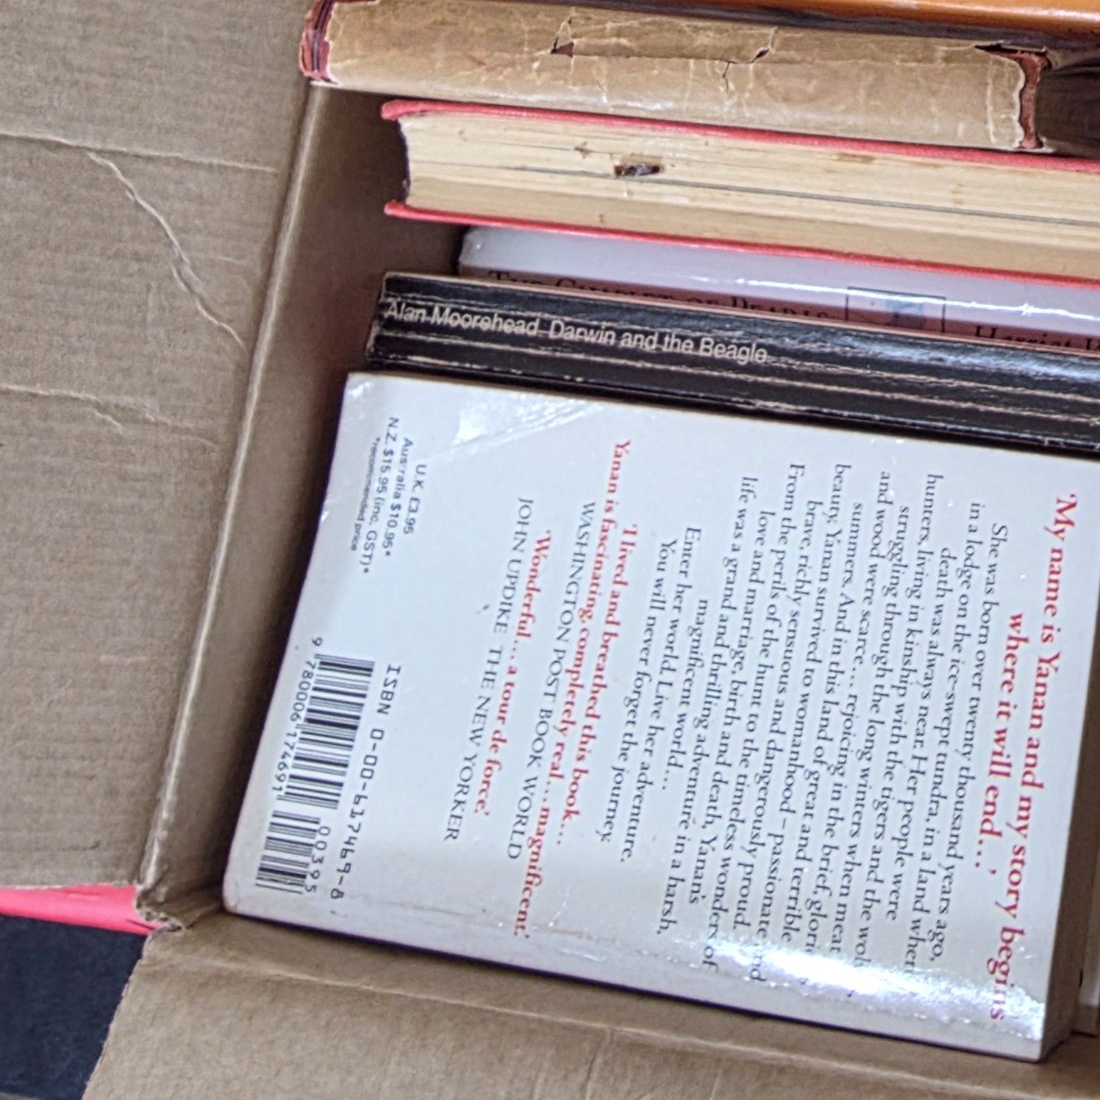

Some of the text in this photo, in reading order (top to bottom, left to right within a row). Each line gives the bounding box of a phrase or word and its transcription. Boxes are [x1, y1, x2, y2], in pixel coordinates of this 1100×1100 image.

[384, 300, 769, 367] Alan Moorehead Darwin and the Beagle
[375, 447, 394, 494] $15.95
[391, 436, 413, 500] Australia
[606, 439, 631, 494] Yanan
[367, 495, 385, 525] (inc.
[402, 463, 427, 534] U.K. £3.95
[603, 498, 618, 513] is
[1046, 492, 1078, 541] 'My
[349, 522, 362, 551] price
[611, 539, 636, 586] lived
[577, 517, 617, 623] fascinating,
[1042, 546, 1063, 617] name
[603, 589, 621, 626] and
[1039, 622, 1061, 643] is
[442, 496, 534, 841] JOHN UPDIKE THE NEW YORKER
[506, 664, 517, 675] a
[506, 500, 596, 859] WASHINGTON POST BOOK WORLD
[551, 626, 589, 736] completely
[583, 630, 619, 720] breathed
[999, 612, 1029, 694] where
[288, 652, 320, 730] 780006
[495, 680, 515, 724] tour
[995, 699, 1018, 720] it
[1027, 652, 1059, 730] Yanan
[270, 730, 298, 798] 174691
[488, 728, 508, 754] de
[574, 723, 597, 762] this
[927, 521, 1008, 962] She was born over twenty thousand years ago,
[987, 726, 1012, 778] will
[1019, 735, 1042, 789] and
[329, 662, 402, 900] ISBN 0-00-617469-8
[1006, 794, 1032, 839] my
[302, 823, 331, 893] 00395
[995, 843, 1026, 919] story
